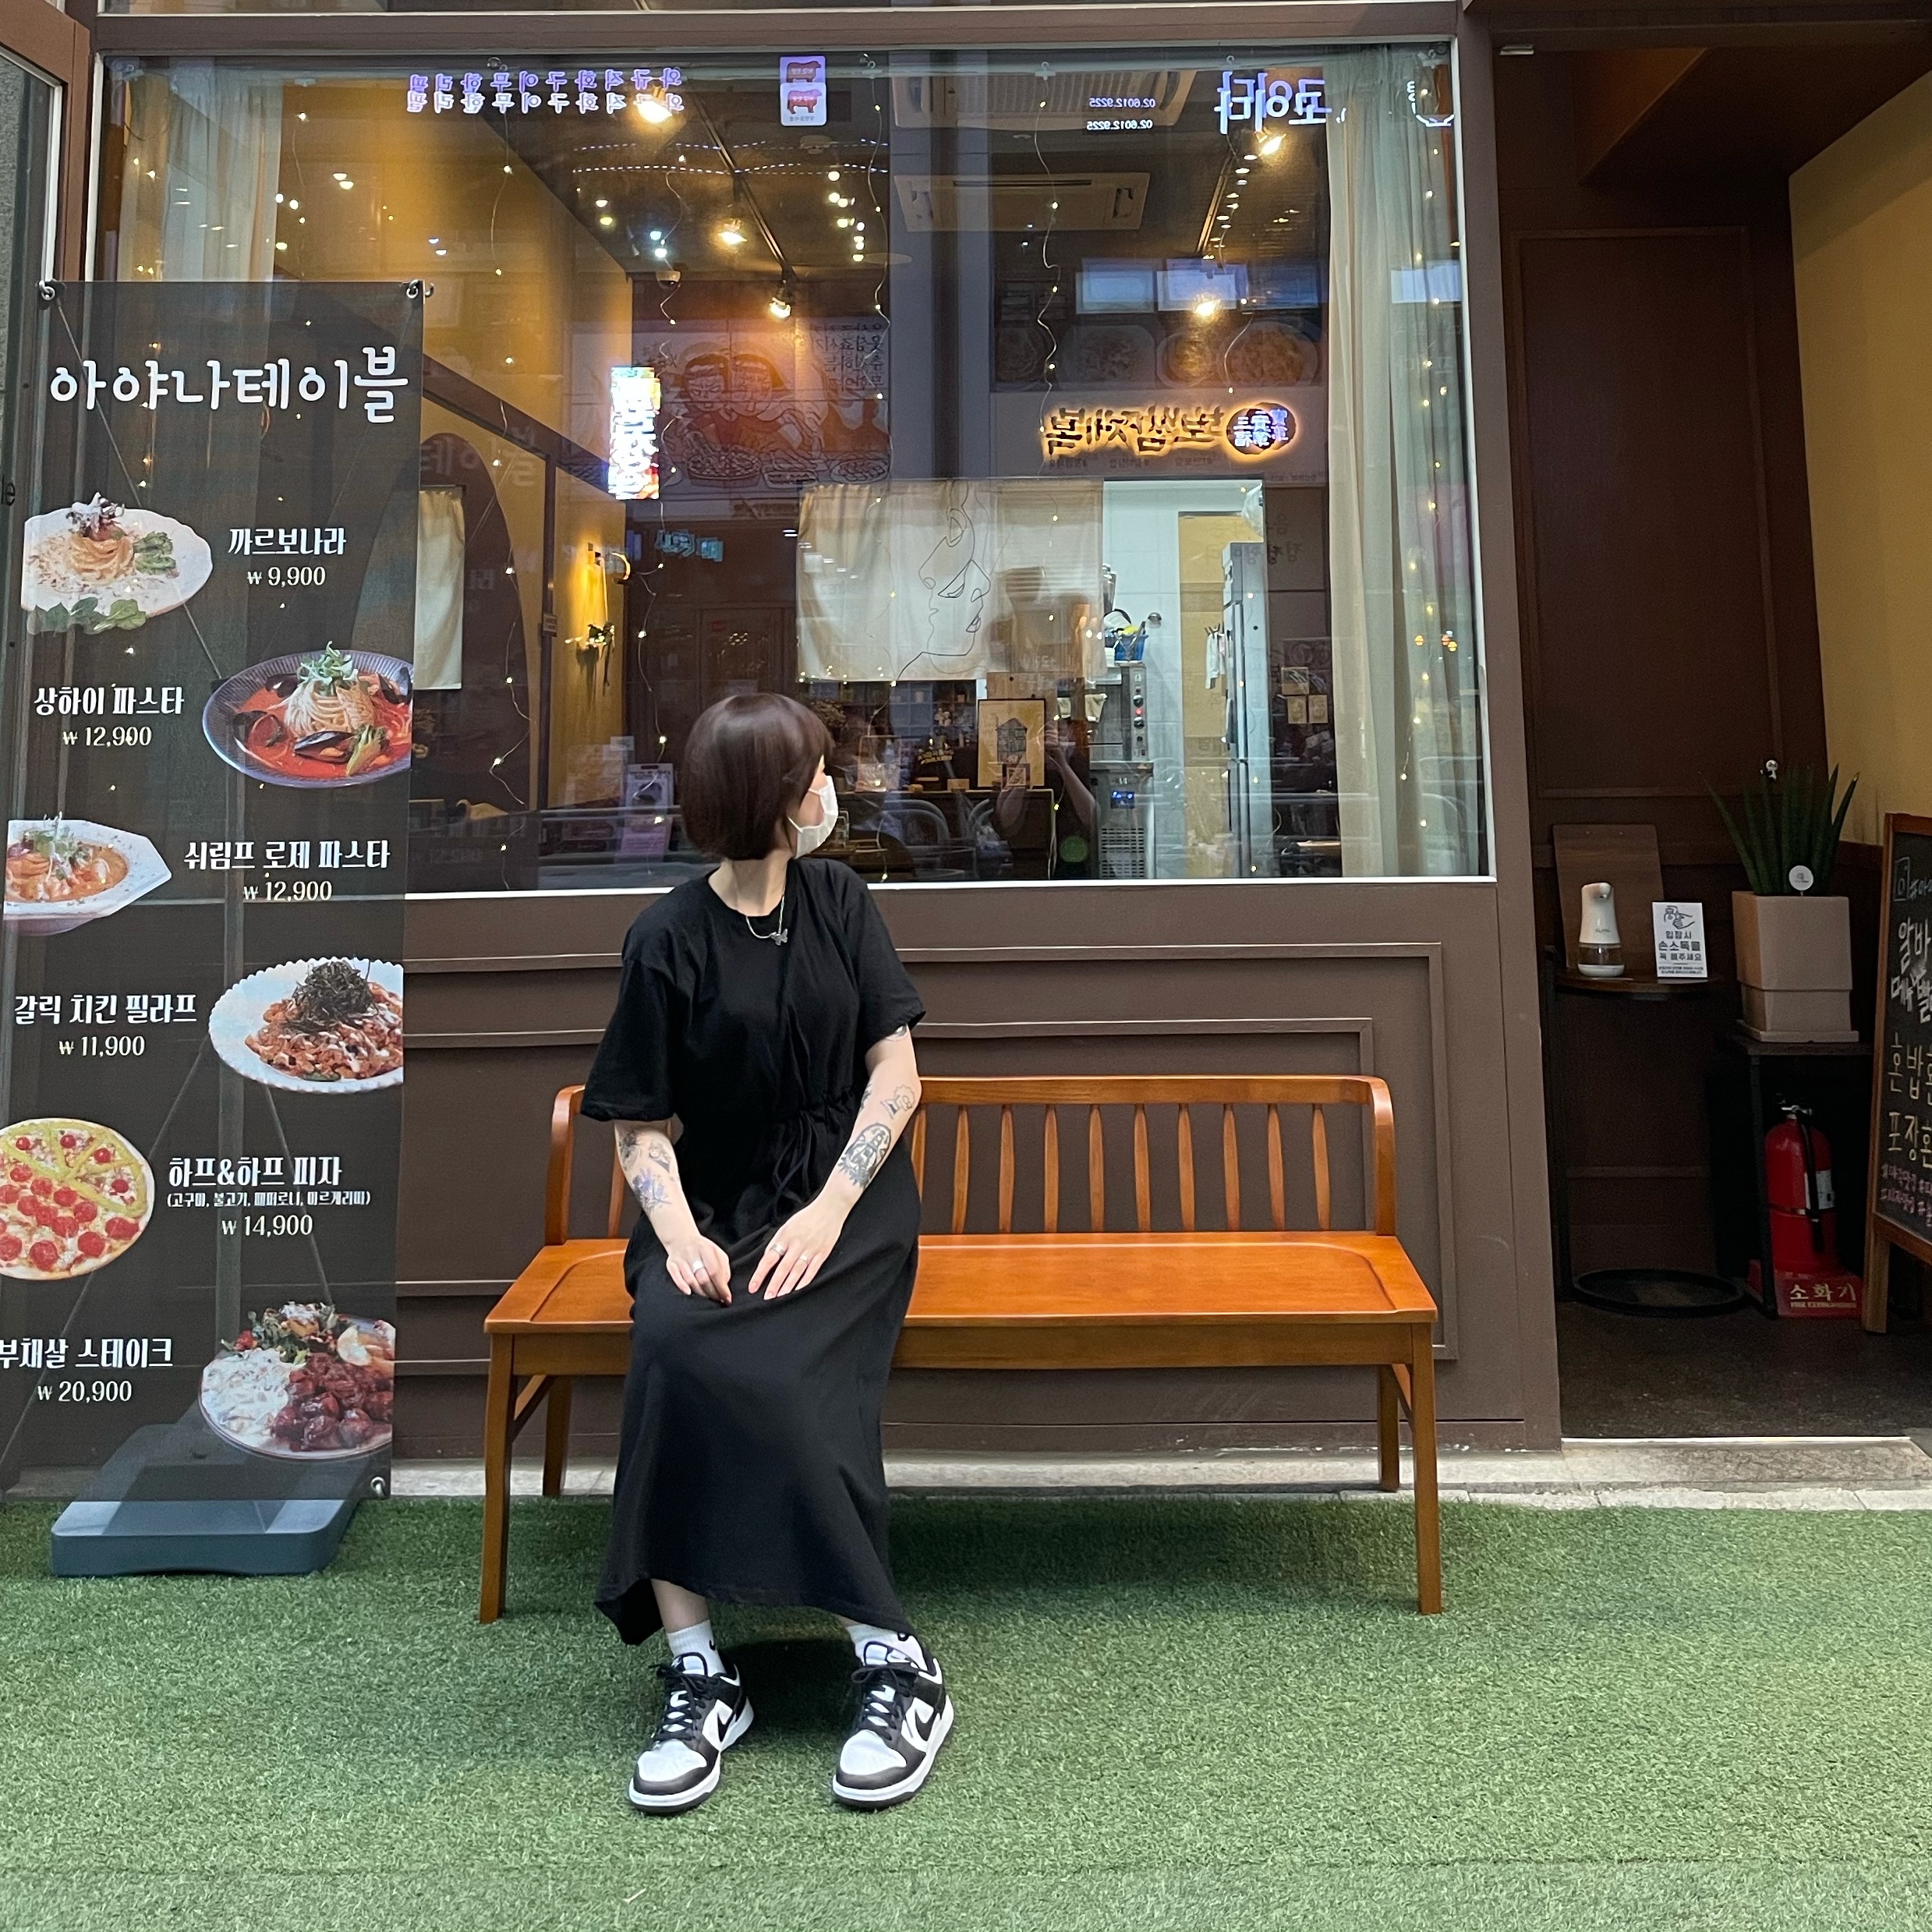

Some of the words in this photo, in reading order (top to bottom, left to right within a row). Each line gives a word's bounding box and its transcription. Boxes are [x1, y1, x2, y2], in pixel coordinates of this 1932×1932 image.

[50, 345, 409, 423] 아야나테이블
[228, 527, 347, 556] 까르보나라
[267, 566, 326, 588] 9,900
[34, 686, 104, 716] 상하이
[112, 686, 185, 715] 파스타
[85, 726, 152, 748] 12,900
[183, 841, 256, 870] 쉬림프
[263, 840, 310, 869] 로제
[318, 840, 391, 869] 파스타
[265, 880, 334, 902] 12,900
[14, 995, 61, 1025] 갈릭
[69, 994, 117, 1024] 치킨
[125, 994, 197, 1024] 필라프
[81, 1035, 145, 1058] 11,900
[168, 1156, 285, 1187] 하프&하프
[292, 1156, 342, 1186] 피자
[243, 1214, 313, 1237] 14,900
[1789, 1283, 1856, 1301] 소화기
[0, 1338, 69, 1369] 부채살
[75, 1338, 173, 1368] 스테이크
[58, 1380, 132, 1403] 20,900
